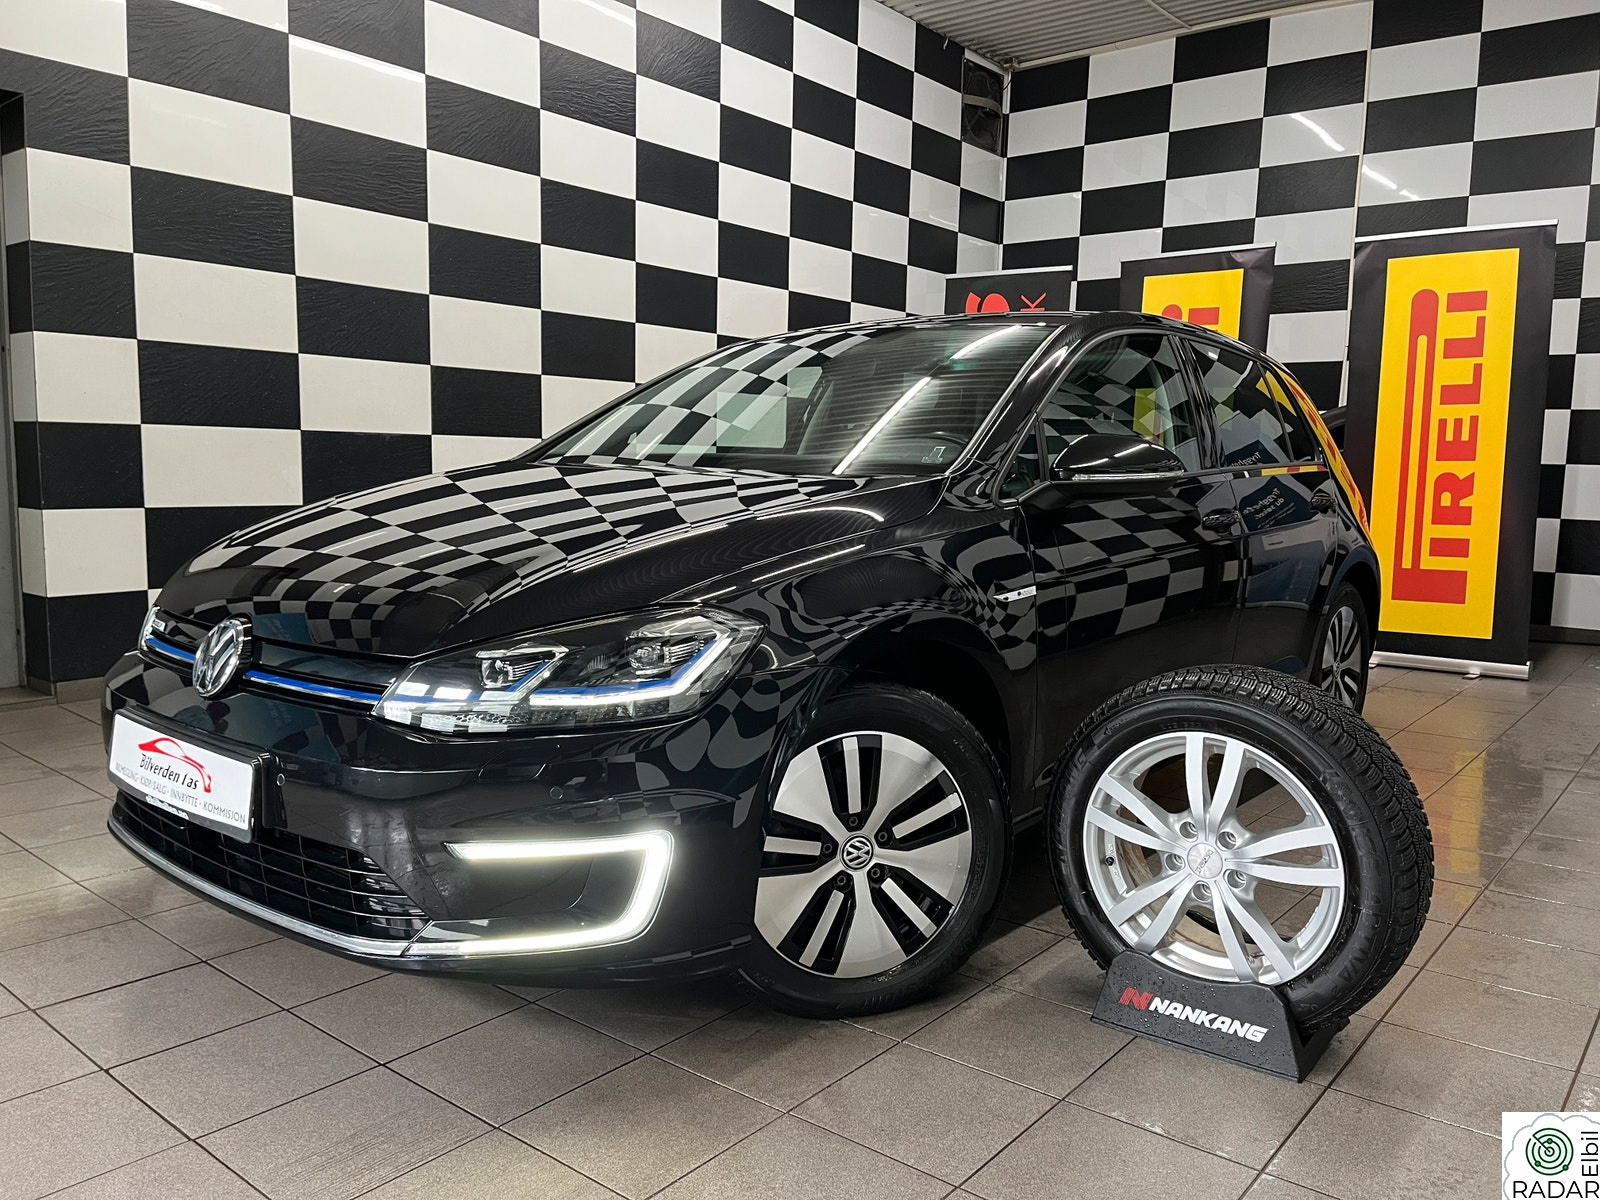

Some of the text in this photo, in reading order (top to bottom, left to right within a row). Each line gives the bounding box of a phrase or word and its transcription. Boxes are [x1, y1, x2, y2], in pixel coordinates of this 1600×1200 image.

[1391, 288, 1488, 604] PIRELLI
[140, 753, 180, 783] Bilverden
[202, 800, 246, 824] KOMMISJON
[1149, 997, 1269, 1043] NANKANG
